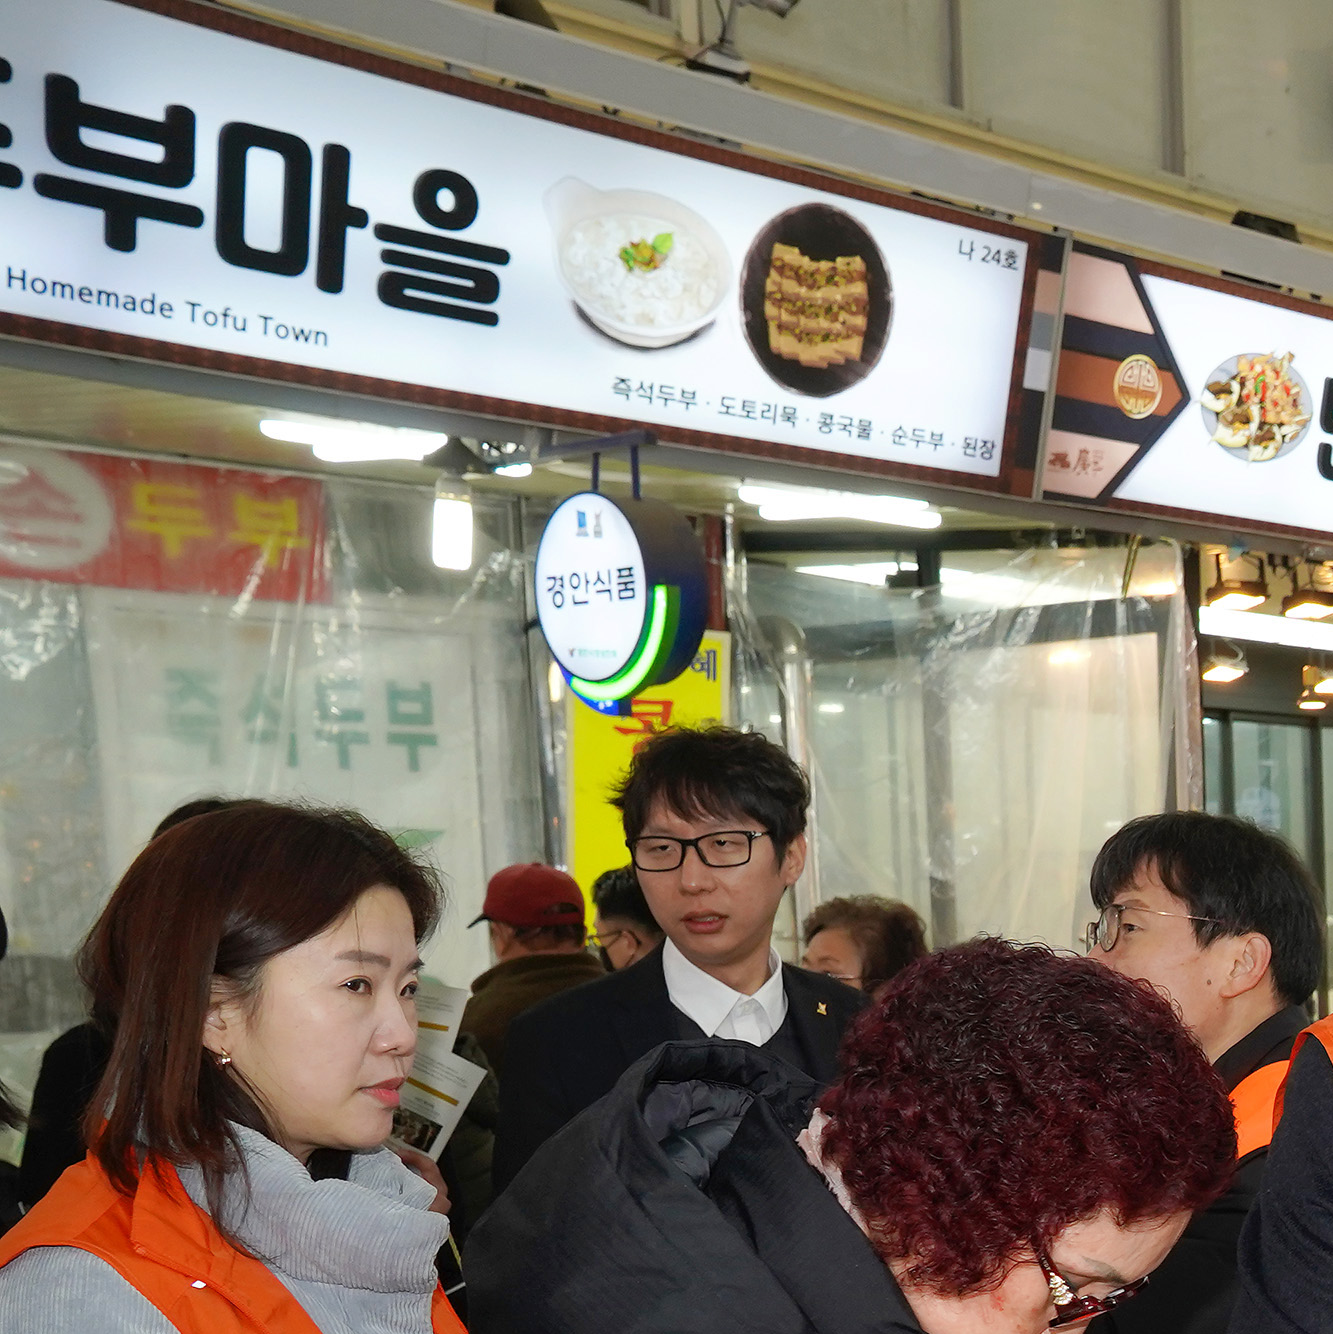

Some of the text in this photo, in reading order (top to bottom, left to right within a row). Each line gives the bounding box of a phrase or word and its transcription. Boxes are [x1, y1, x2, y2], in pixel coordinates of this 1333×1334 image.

[959, 238, 1020, 272] 나 24호
[6, 266, 330, 348] Homemade Tofu Town
[611, 376, 997, 462] 즉석두부 도토리묵 콩국물 순두부 된장
[546, 565, 636, 609] 경안식품
